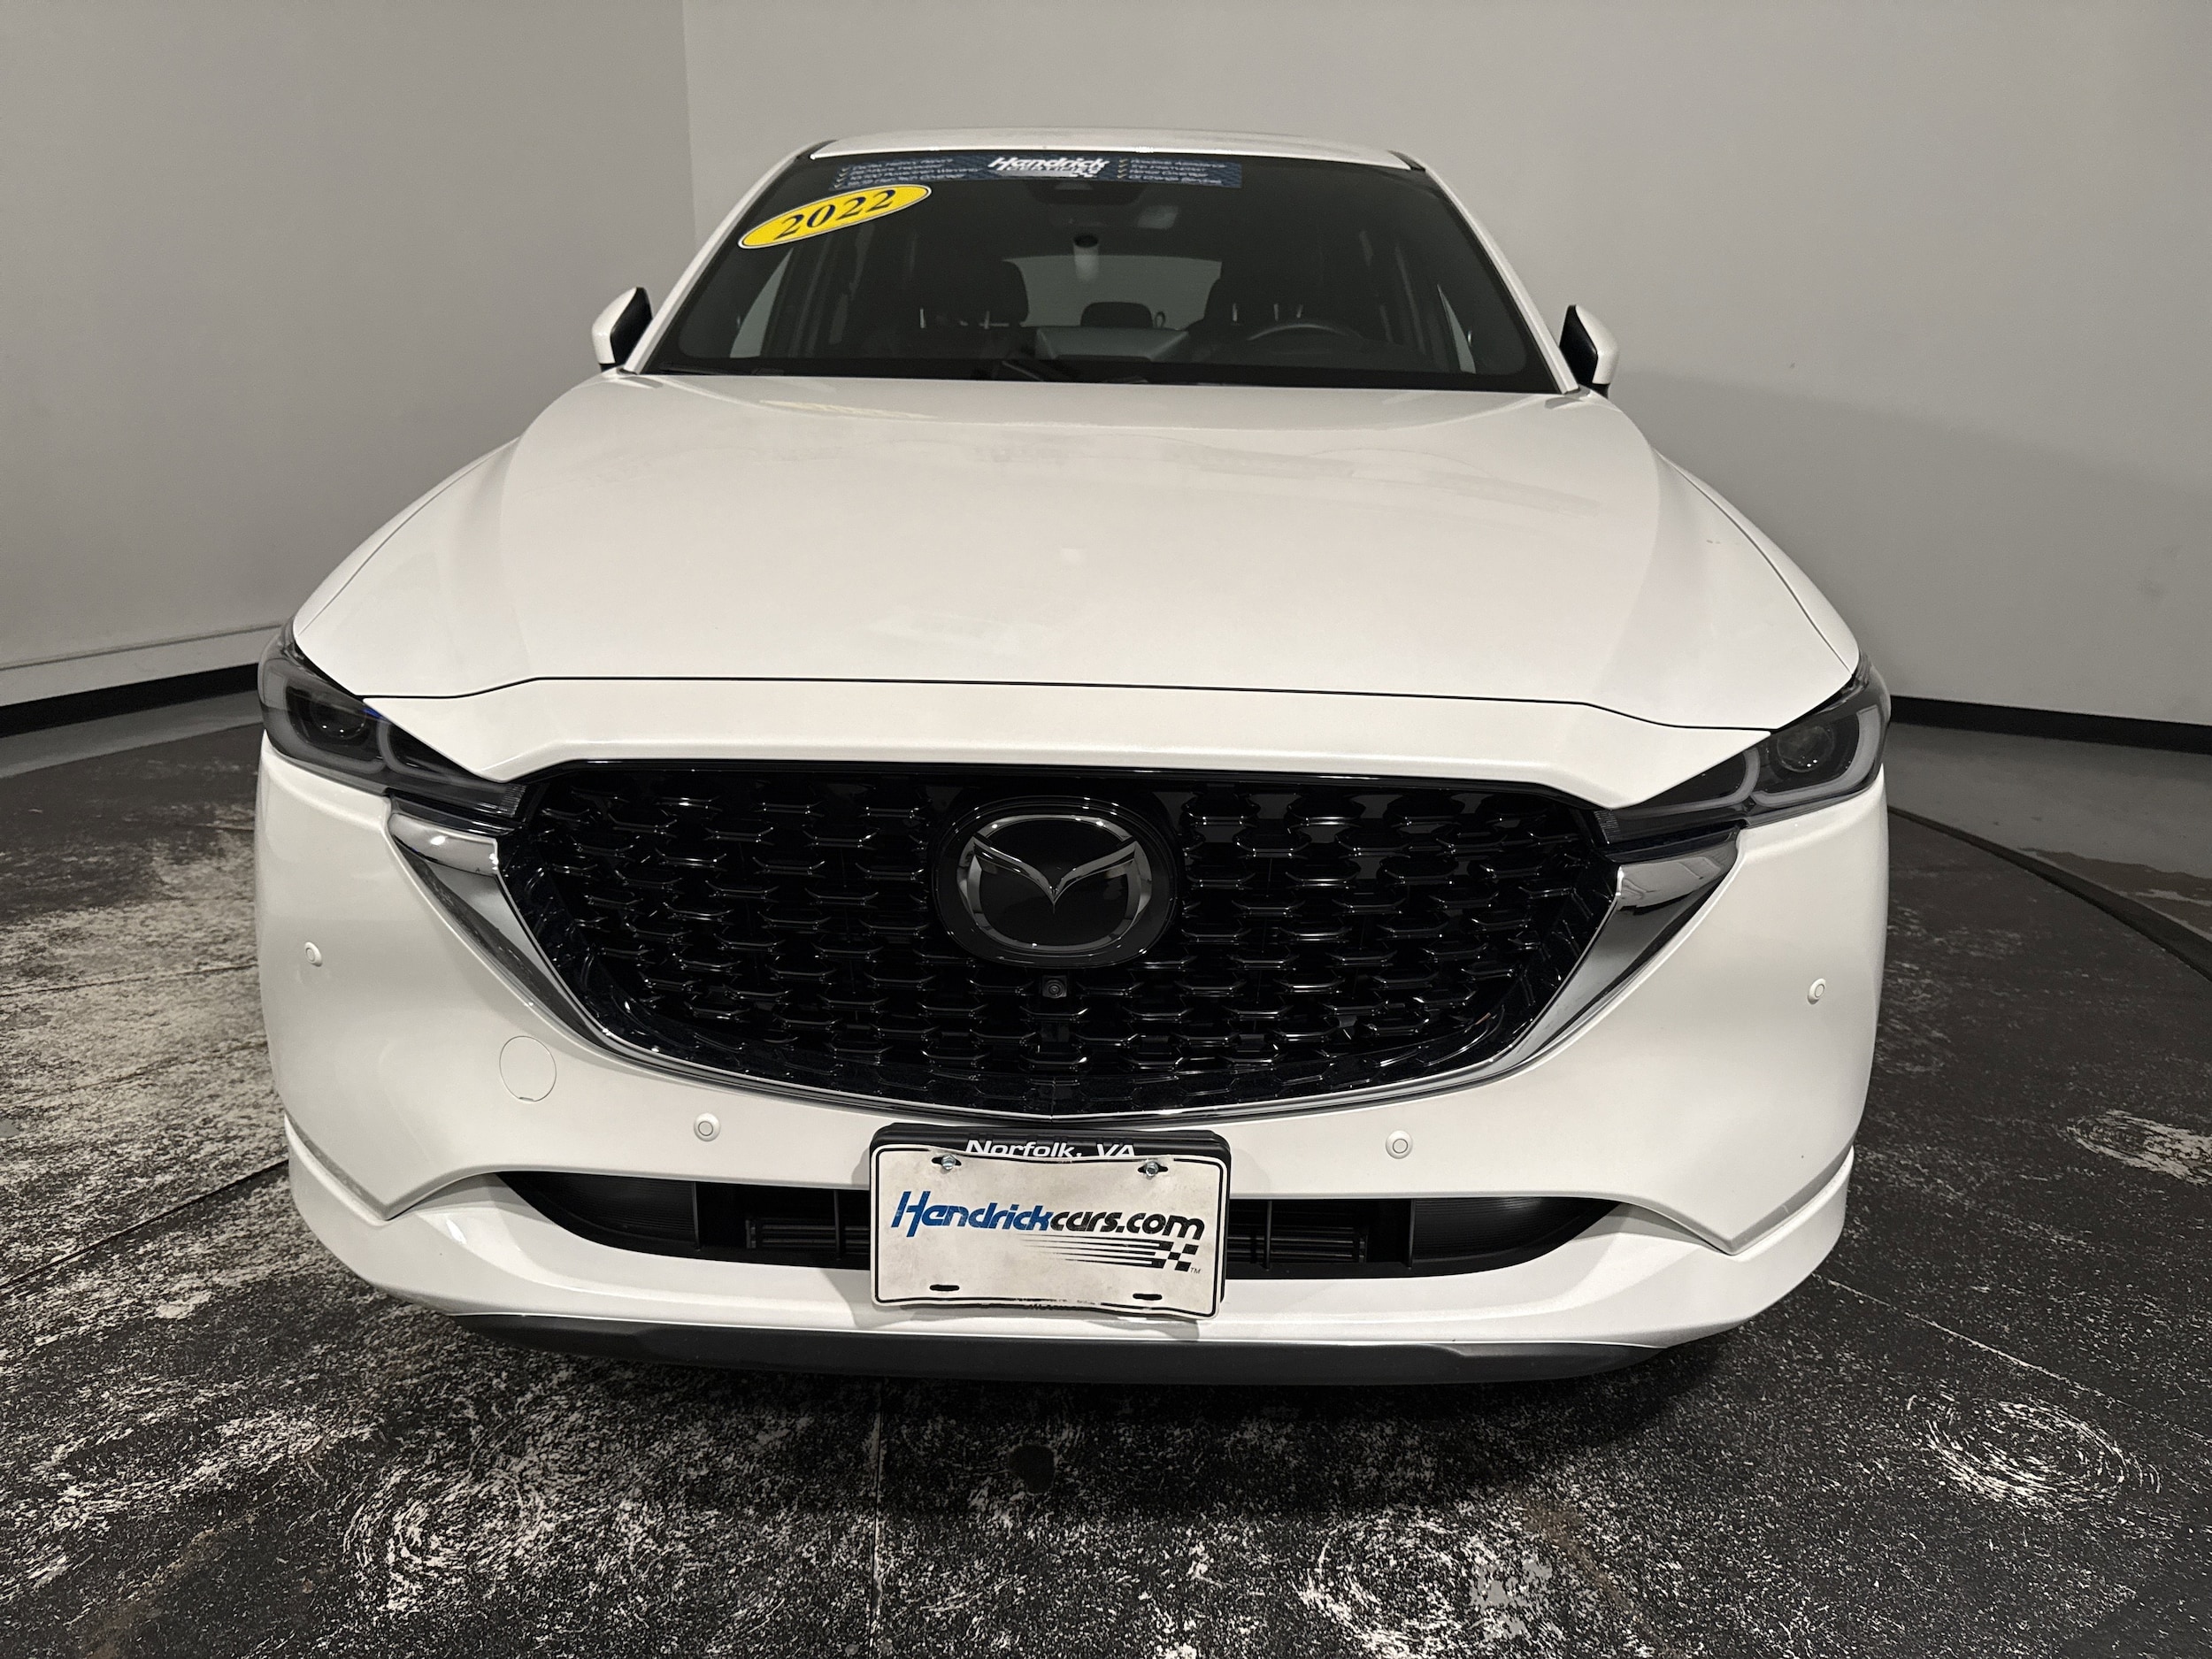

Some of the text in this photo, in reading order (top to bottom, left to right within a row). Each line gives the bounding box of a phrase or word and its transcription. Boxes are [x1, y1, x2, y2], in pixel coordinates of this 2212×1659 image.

[987, 157, 1110, 172] Hendrick
[773, 189, 895, 240] 2022
[965, 1139, 1135, 1158] Norfolk, VA
[891, 1190, 1205, 1240] Hendrickcars.com
